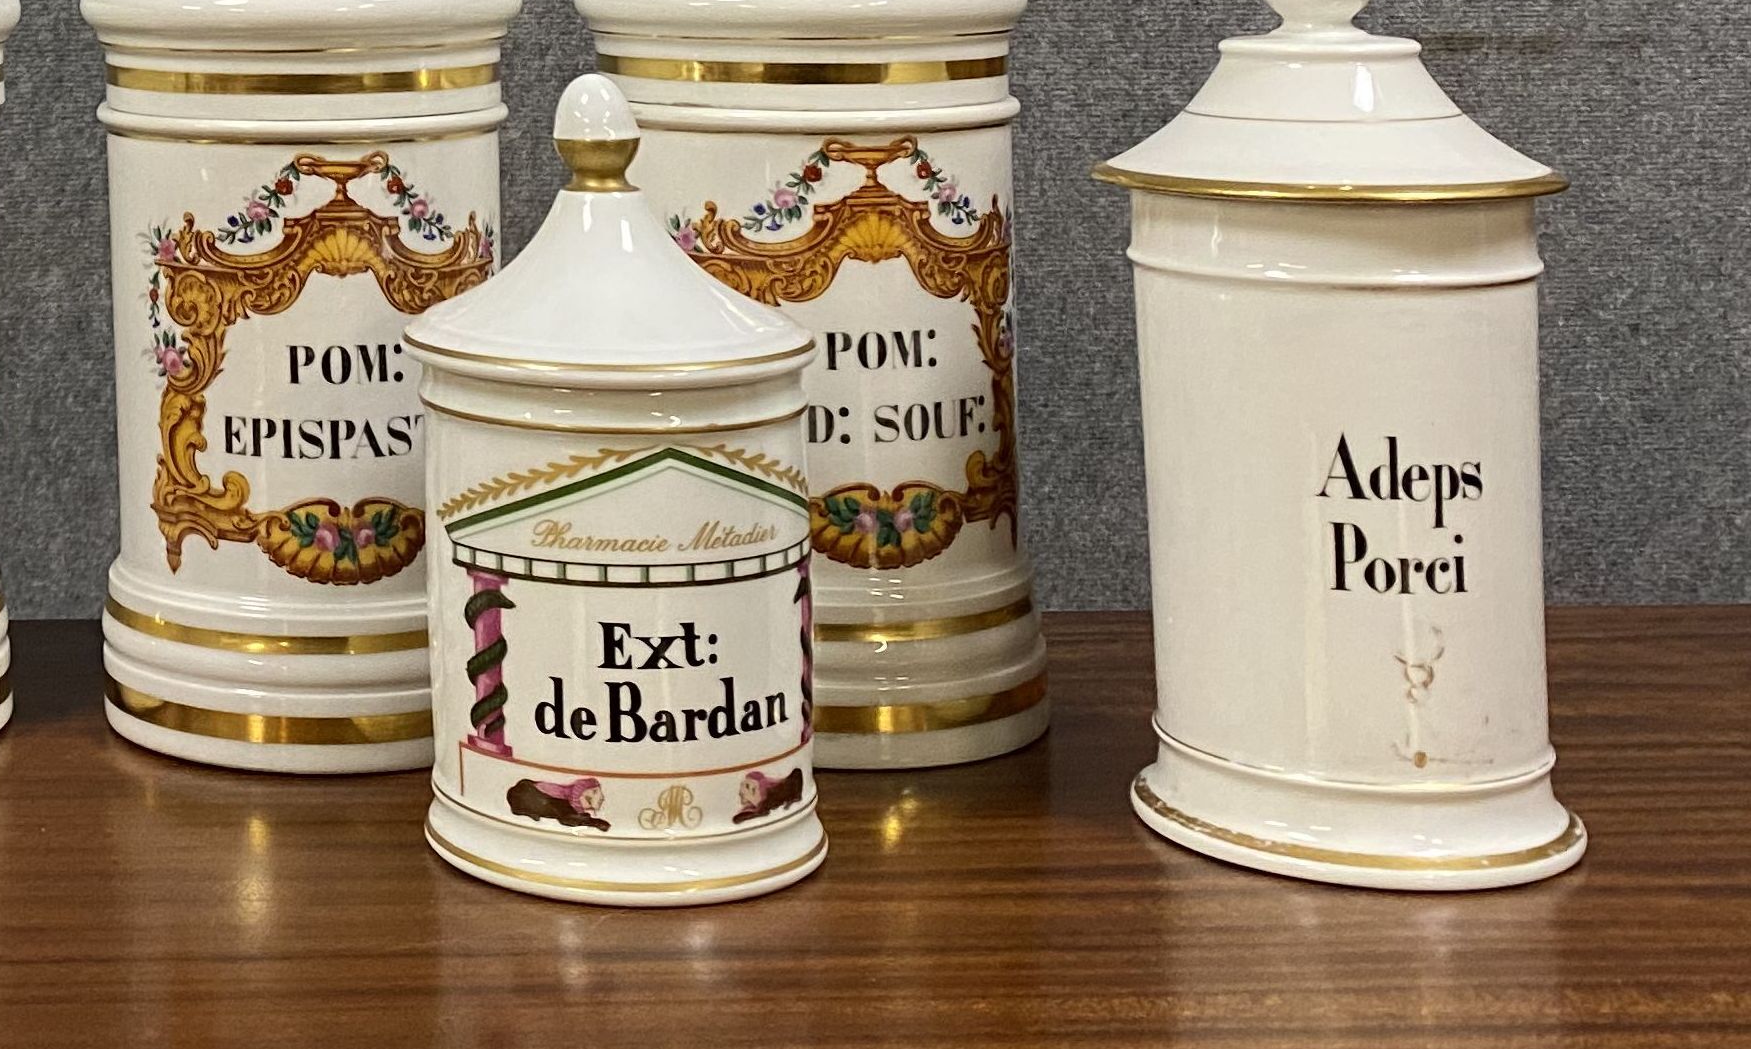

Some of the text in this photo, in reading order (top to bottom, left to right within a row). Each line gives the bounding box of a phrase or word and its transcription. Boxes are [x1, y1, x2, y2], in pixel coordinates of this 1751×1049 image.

[286, 343, 404, 385] POM:
[825, 329, 937, 371] POM:
[874, 395, 986, 443] SOUF:
[1315, 432, 1484, 529] Adeps
[530, 519, 778, 553] Pharmacie Métadier
[1329, 521, 1469, 595] Porci
[597, 621, 718, 670] Ext:
[534, 676, 790, 743] de Bardan
